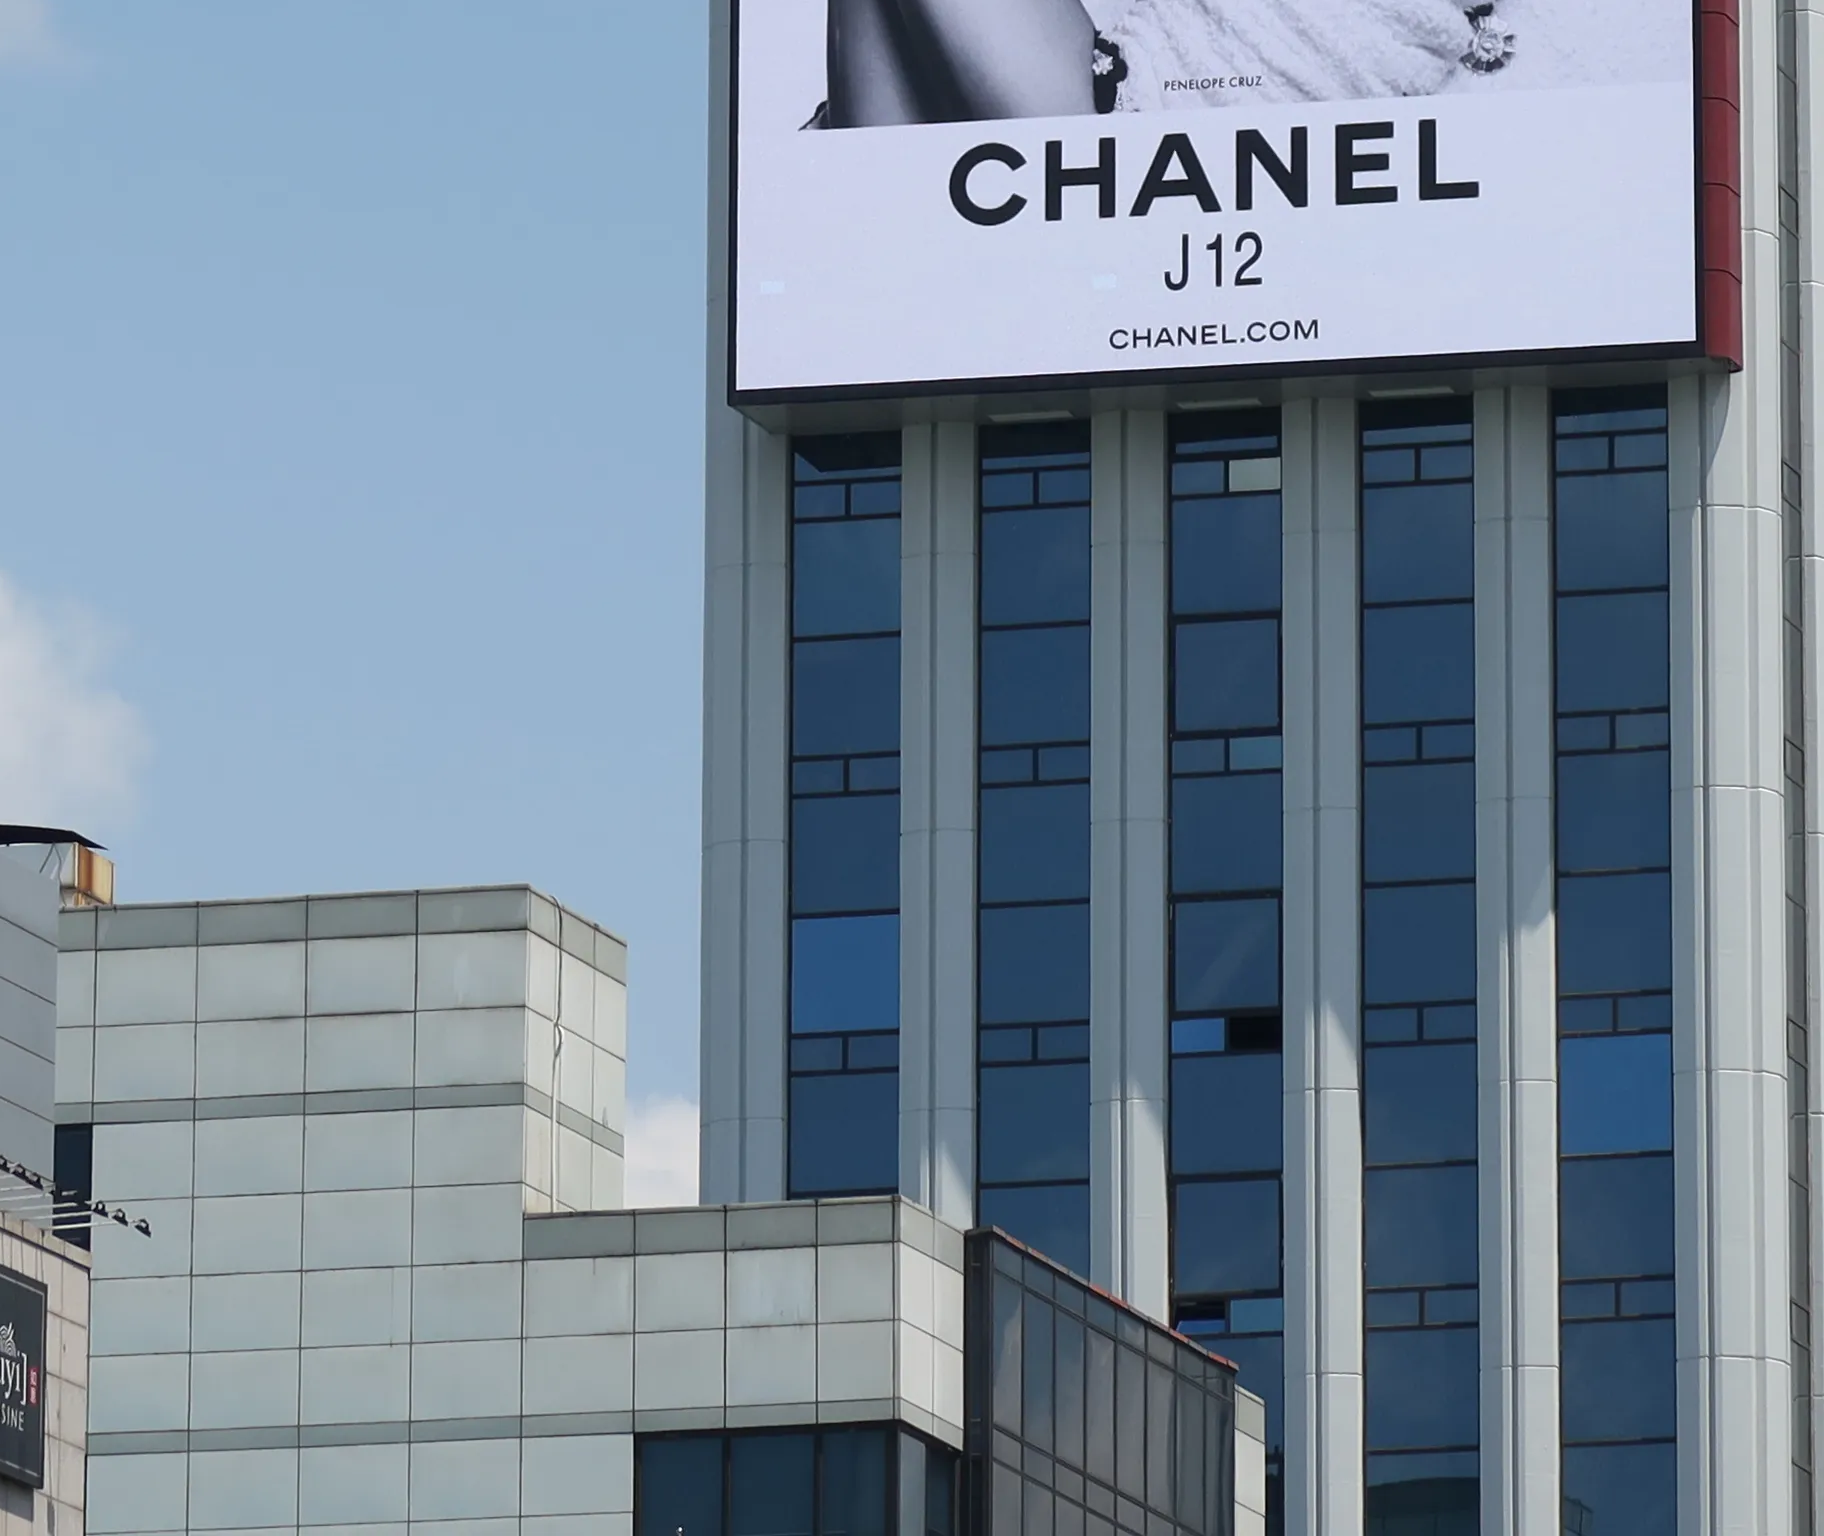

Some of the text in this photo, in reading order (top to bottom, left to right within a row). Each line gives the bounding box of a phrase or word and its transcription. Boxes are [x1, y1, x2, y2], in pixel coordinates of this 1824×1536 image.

[1164, 75, 1263, 91] PENELOPE CRUZ
[949, 119, 1480, 226] CHANEL
[1164, 231, 1263, 291] J12
[1108, 319, 1319, 350] CHANEL.COM
